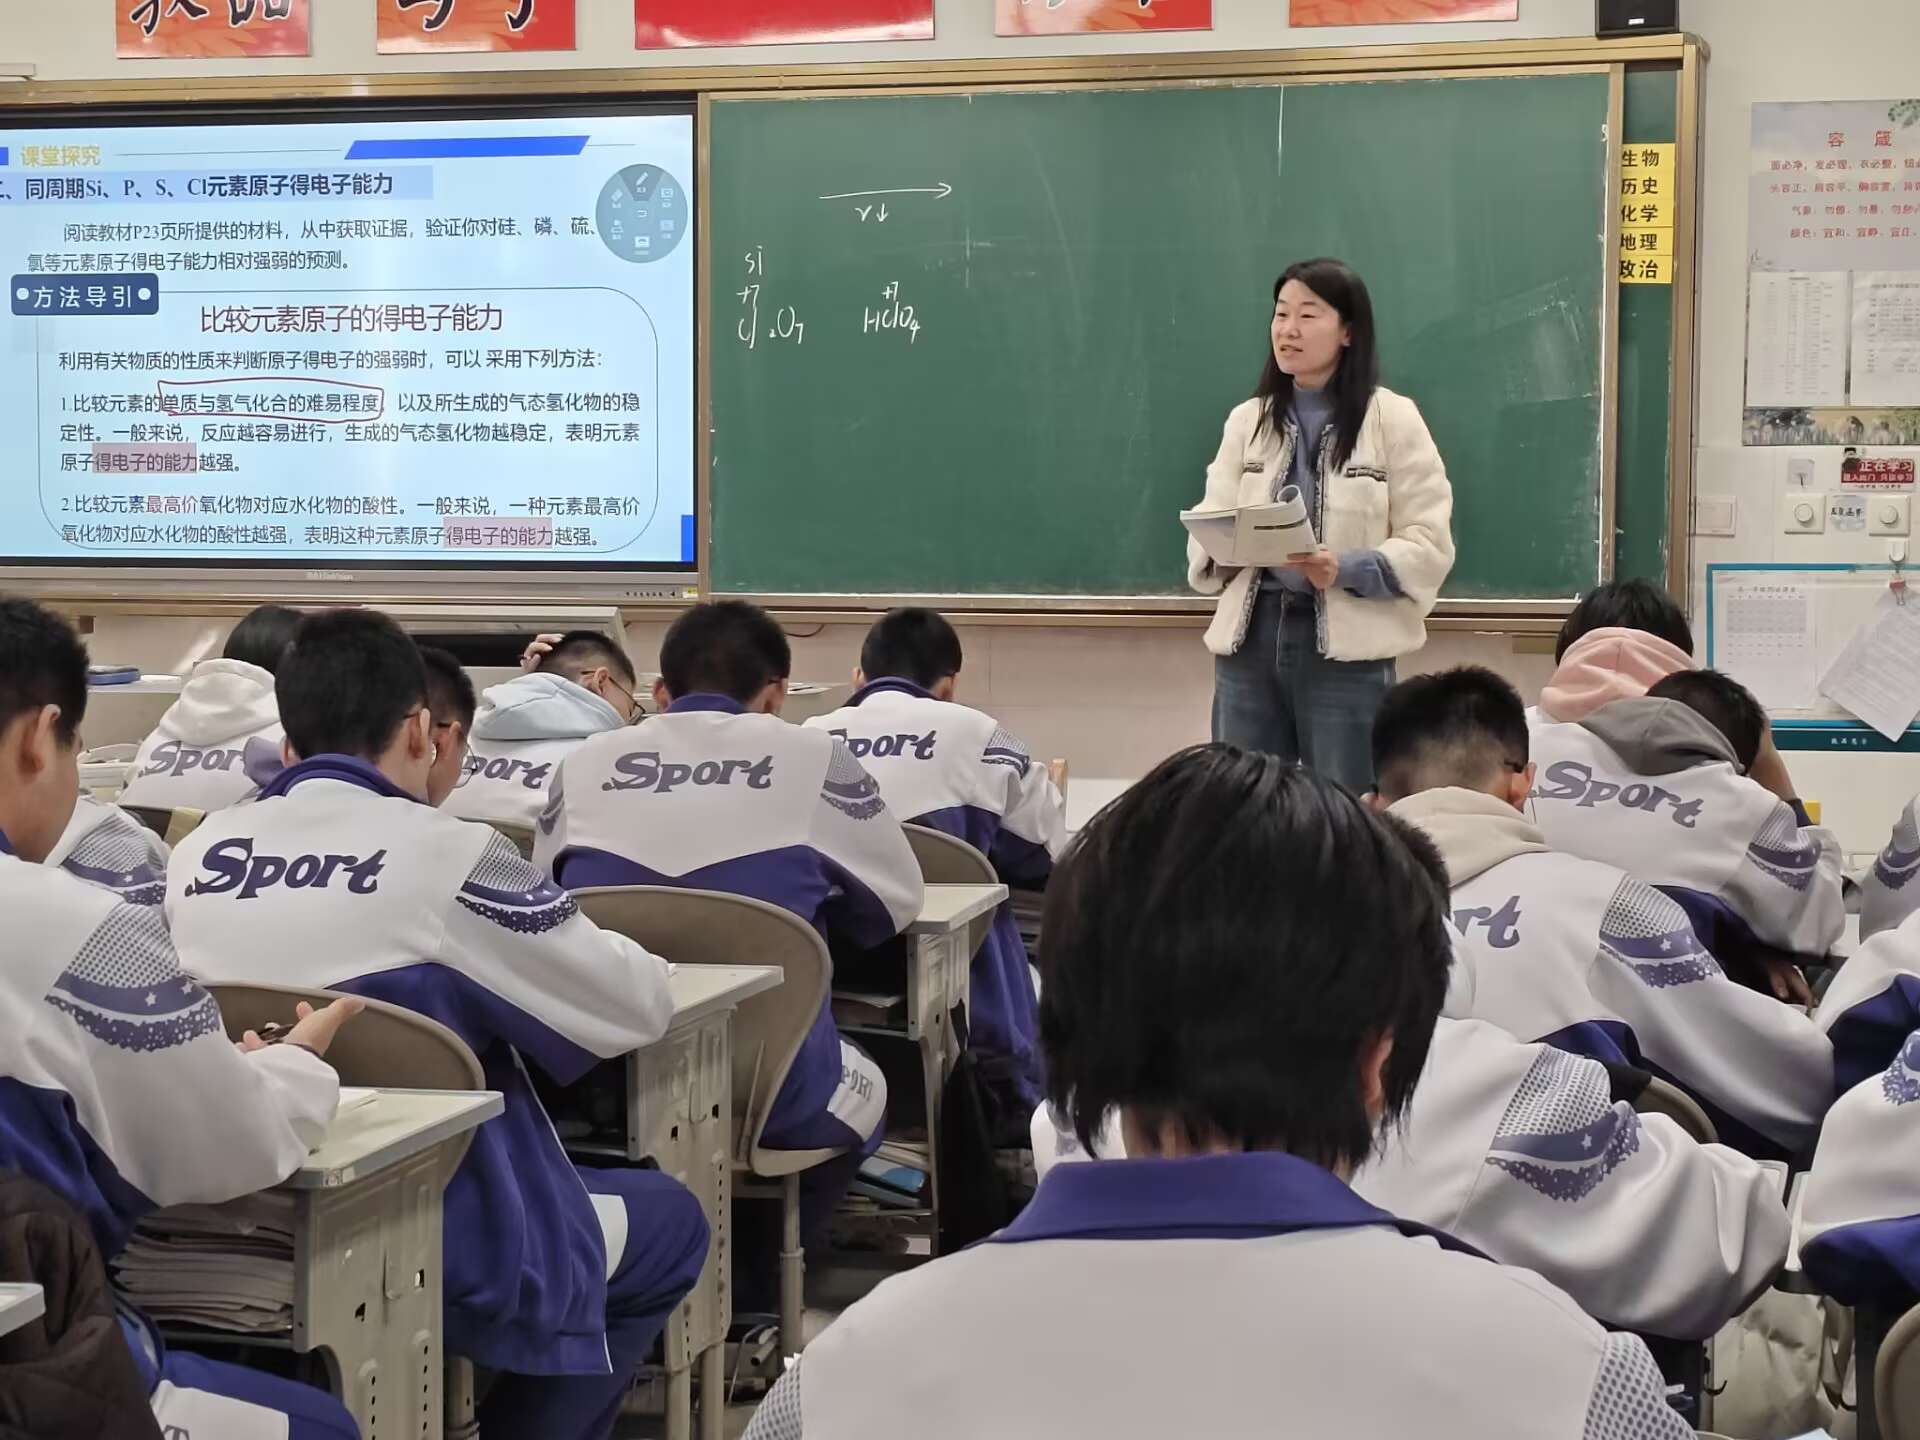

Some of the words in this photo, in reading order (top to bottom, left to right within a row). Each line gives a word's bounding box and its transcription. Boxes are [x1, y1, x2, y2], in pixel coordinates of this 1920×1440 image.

[20, 145, 101, 167] 课堂探究
[1622, 149, 1660, 168] 生物
[0, 172, 393, 200] 、同周期Si、P、S、Cl元素原子得电子能力
[1621, 176, 1659, 195] 历史
[1621, 204, 1659, 223] 化学
[1620, 232, 1658, 251] 地理
[28, 250, 349, 272] 氯等元素原子得电子能力相对强弱的预测。
[1619, 259, 1659, 280] 政治
[33, 285, 131, 309] 方法导引
[201, 302, 502, 332] 比较元素原子的得电子能力
[60, 452, 240, 472] 原子得电子的能力越强。
[1860, 457, 1914, 472] 正在学习
[138, 740, 244, 777] Spor
[463, 755, 552, 789] port
[602, 751, 775, 793] Sport
[1530, 761, 1704, 828] Sport
[185, 837, 388, 899] Sport
